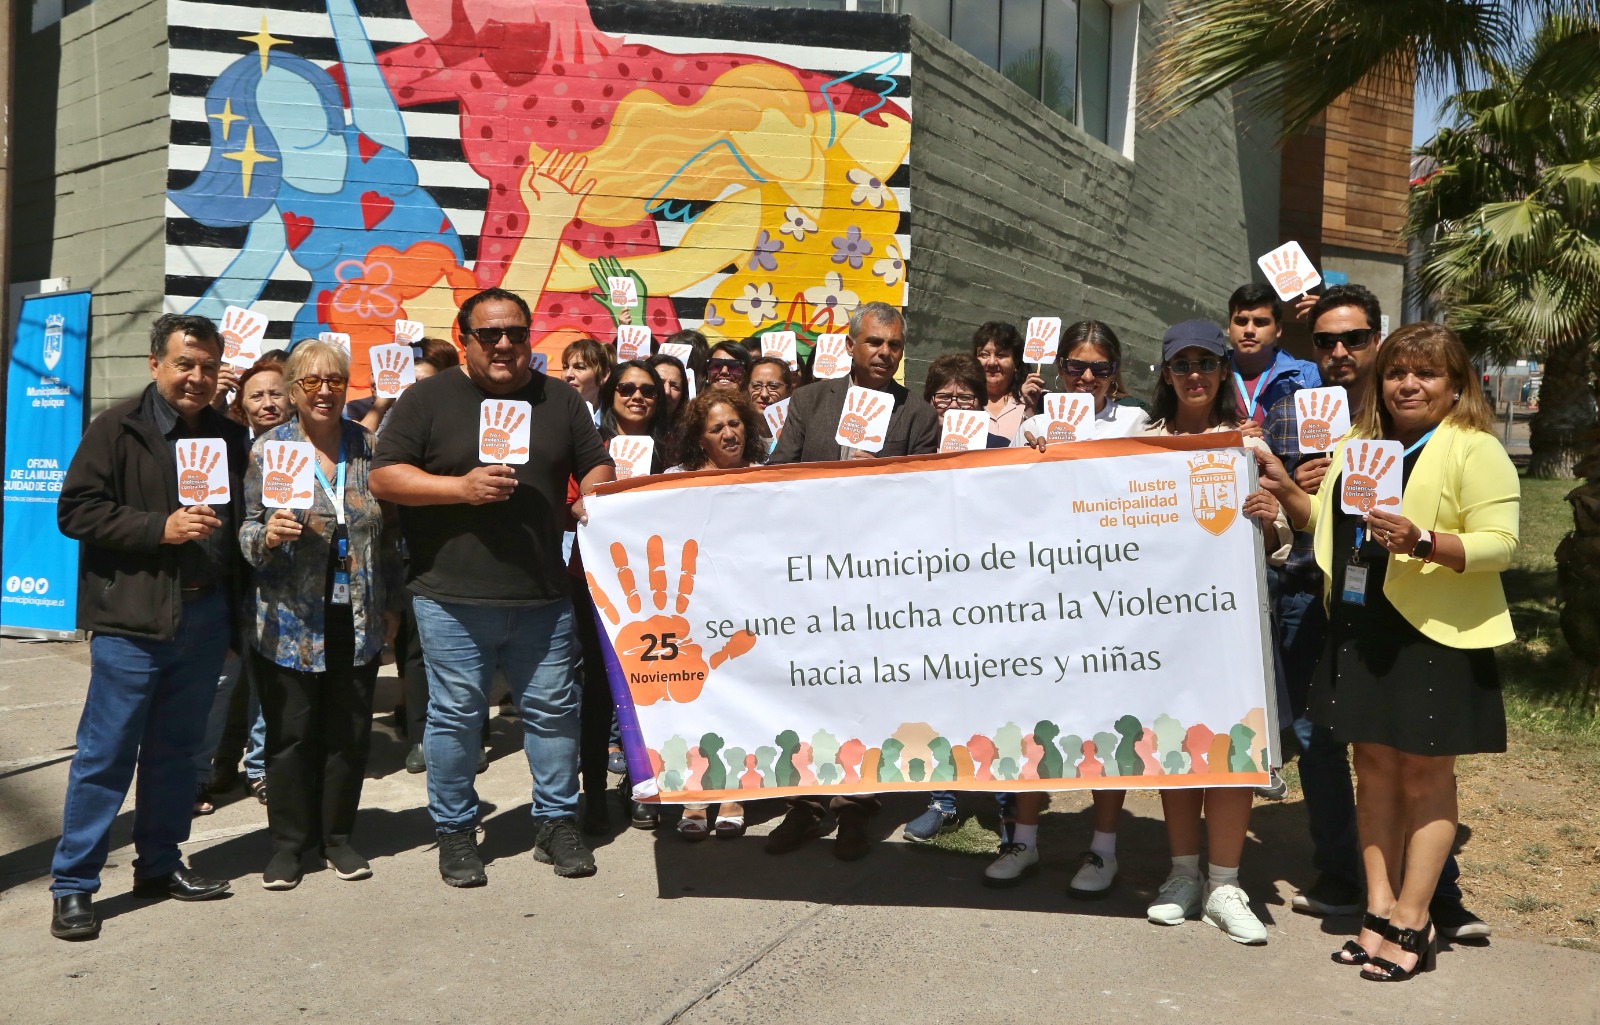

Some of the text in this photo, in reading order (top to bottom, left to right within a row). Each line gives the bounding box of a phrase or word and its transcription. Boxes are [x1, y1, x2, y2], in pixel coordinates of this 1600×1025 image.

[40, 376, 60, 384] Ilustre
[27, 386, 70, 396] Municipalidad
[32, 398, 64, 408] de Iquique
[10, 470, 24, 479] DE
[25, 470, 36, 480] LA
[37, 470, 63, 480] MUJER
[1192, 474, 1234, 484] IQUIQUE
[4, 481, 35, 491] QUIDAD
[35, 482, 46, 491] DE
[1129, 479, 1176, 493] Ilustre
[1072, 494, 1178, 513] Municipalidad
[1099, 512, 1179, 528] de Iquique
[788, 539, 1140, 582] El Municipio de Iquique
[706, 585, 1237, 638] se une a la lucha contra la Violencia
[640, 632, 679, 661] 25
[790, 645, 1162, 686] hacia las Mujeres y niñas
[630, 670, 704, 683] Noviembre
